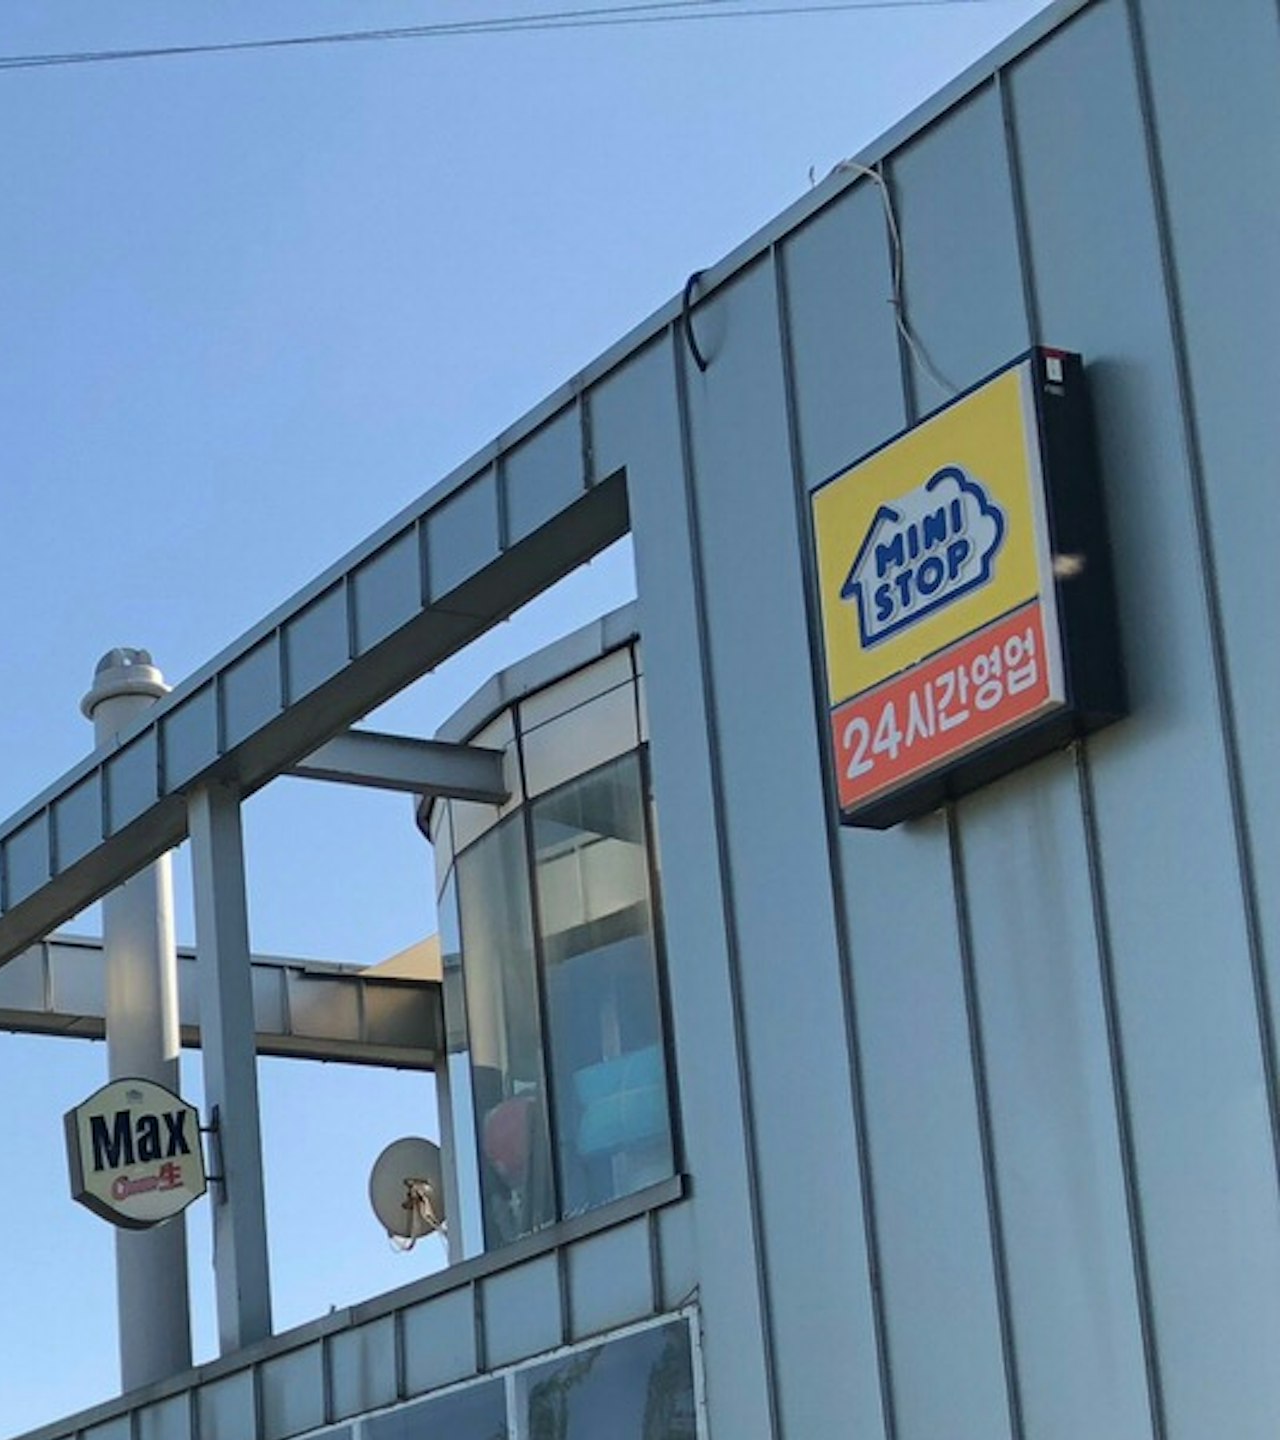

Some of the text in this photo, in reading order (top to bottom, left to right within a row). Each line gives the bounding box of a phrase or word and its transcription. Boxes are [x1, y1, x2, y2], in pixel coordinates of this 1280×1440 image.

[873, 537, 971, 623] STOP
[874, 497, 963, 579] MINI
[842, 626, 1038, 781] 24시간영업
[90, 1109, 191, 1172] Max
